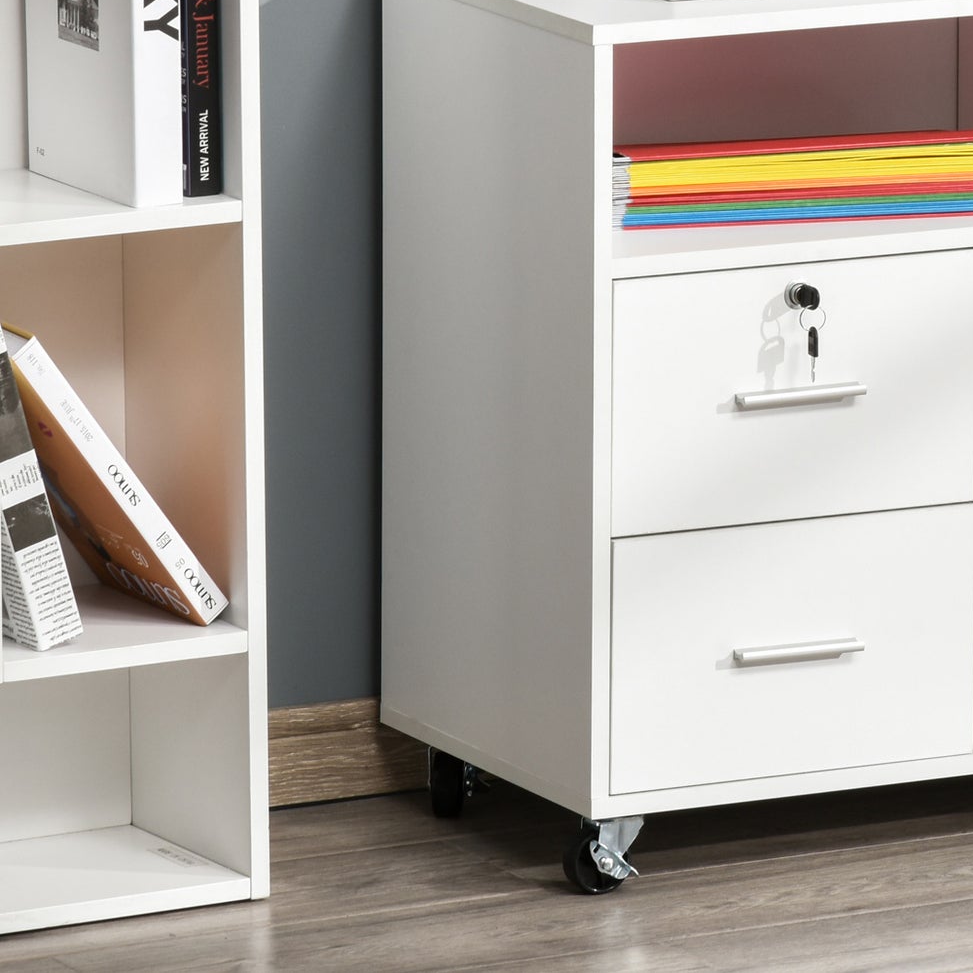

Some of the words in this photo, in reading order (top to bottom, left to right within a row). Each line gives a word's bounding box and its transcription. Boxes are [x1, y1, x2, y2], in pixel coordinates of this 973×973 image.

[193, 9, 212, 88] January
[200, 109, 209, 154] ARRIVAL
[200, 156, 209, 181] NEW
